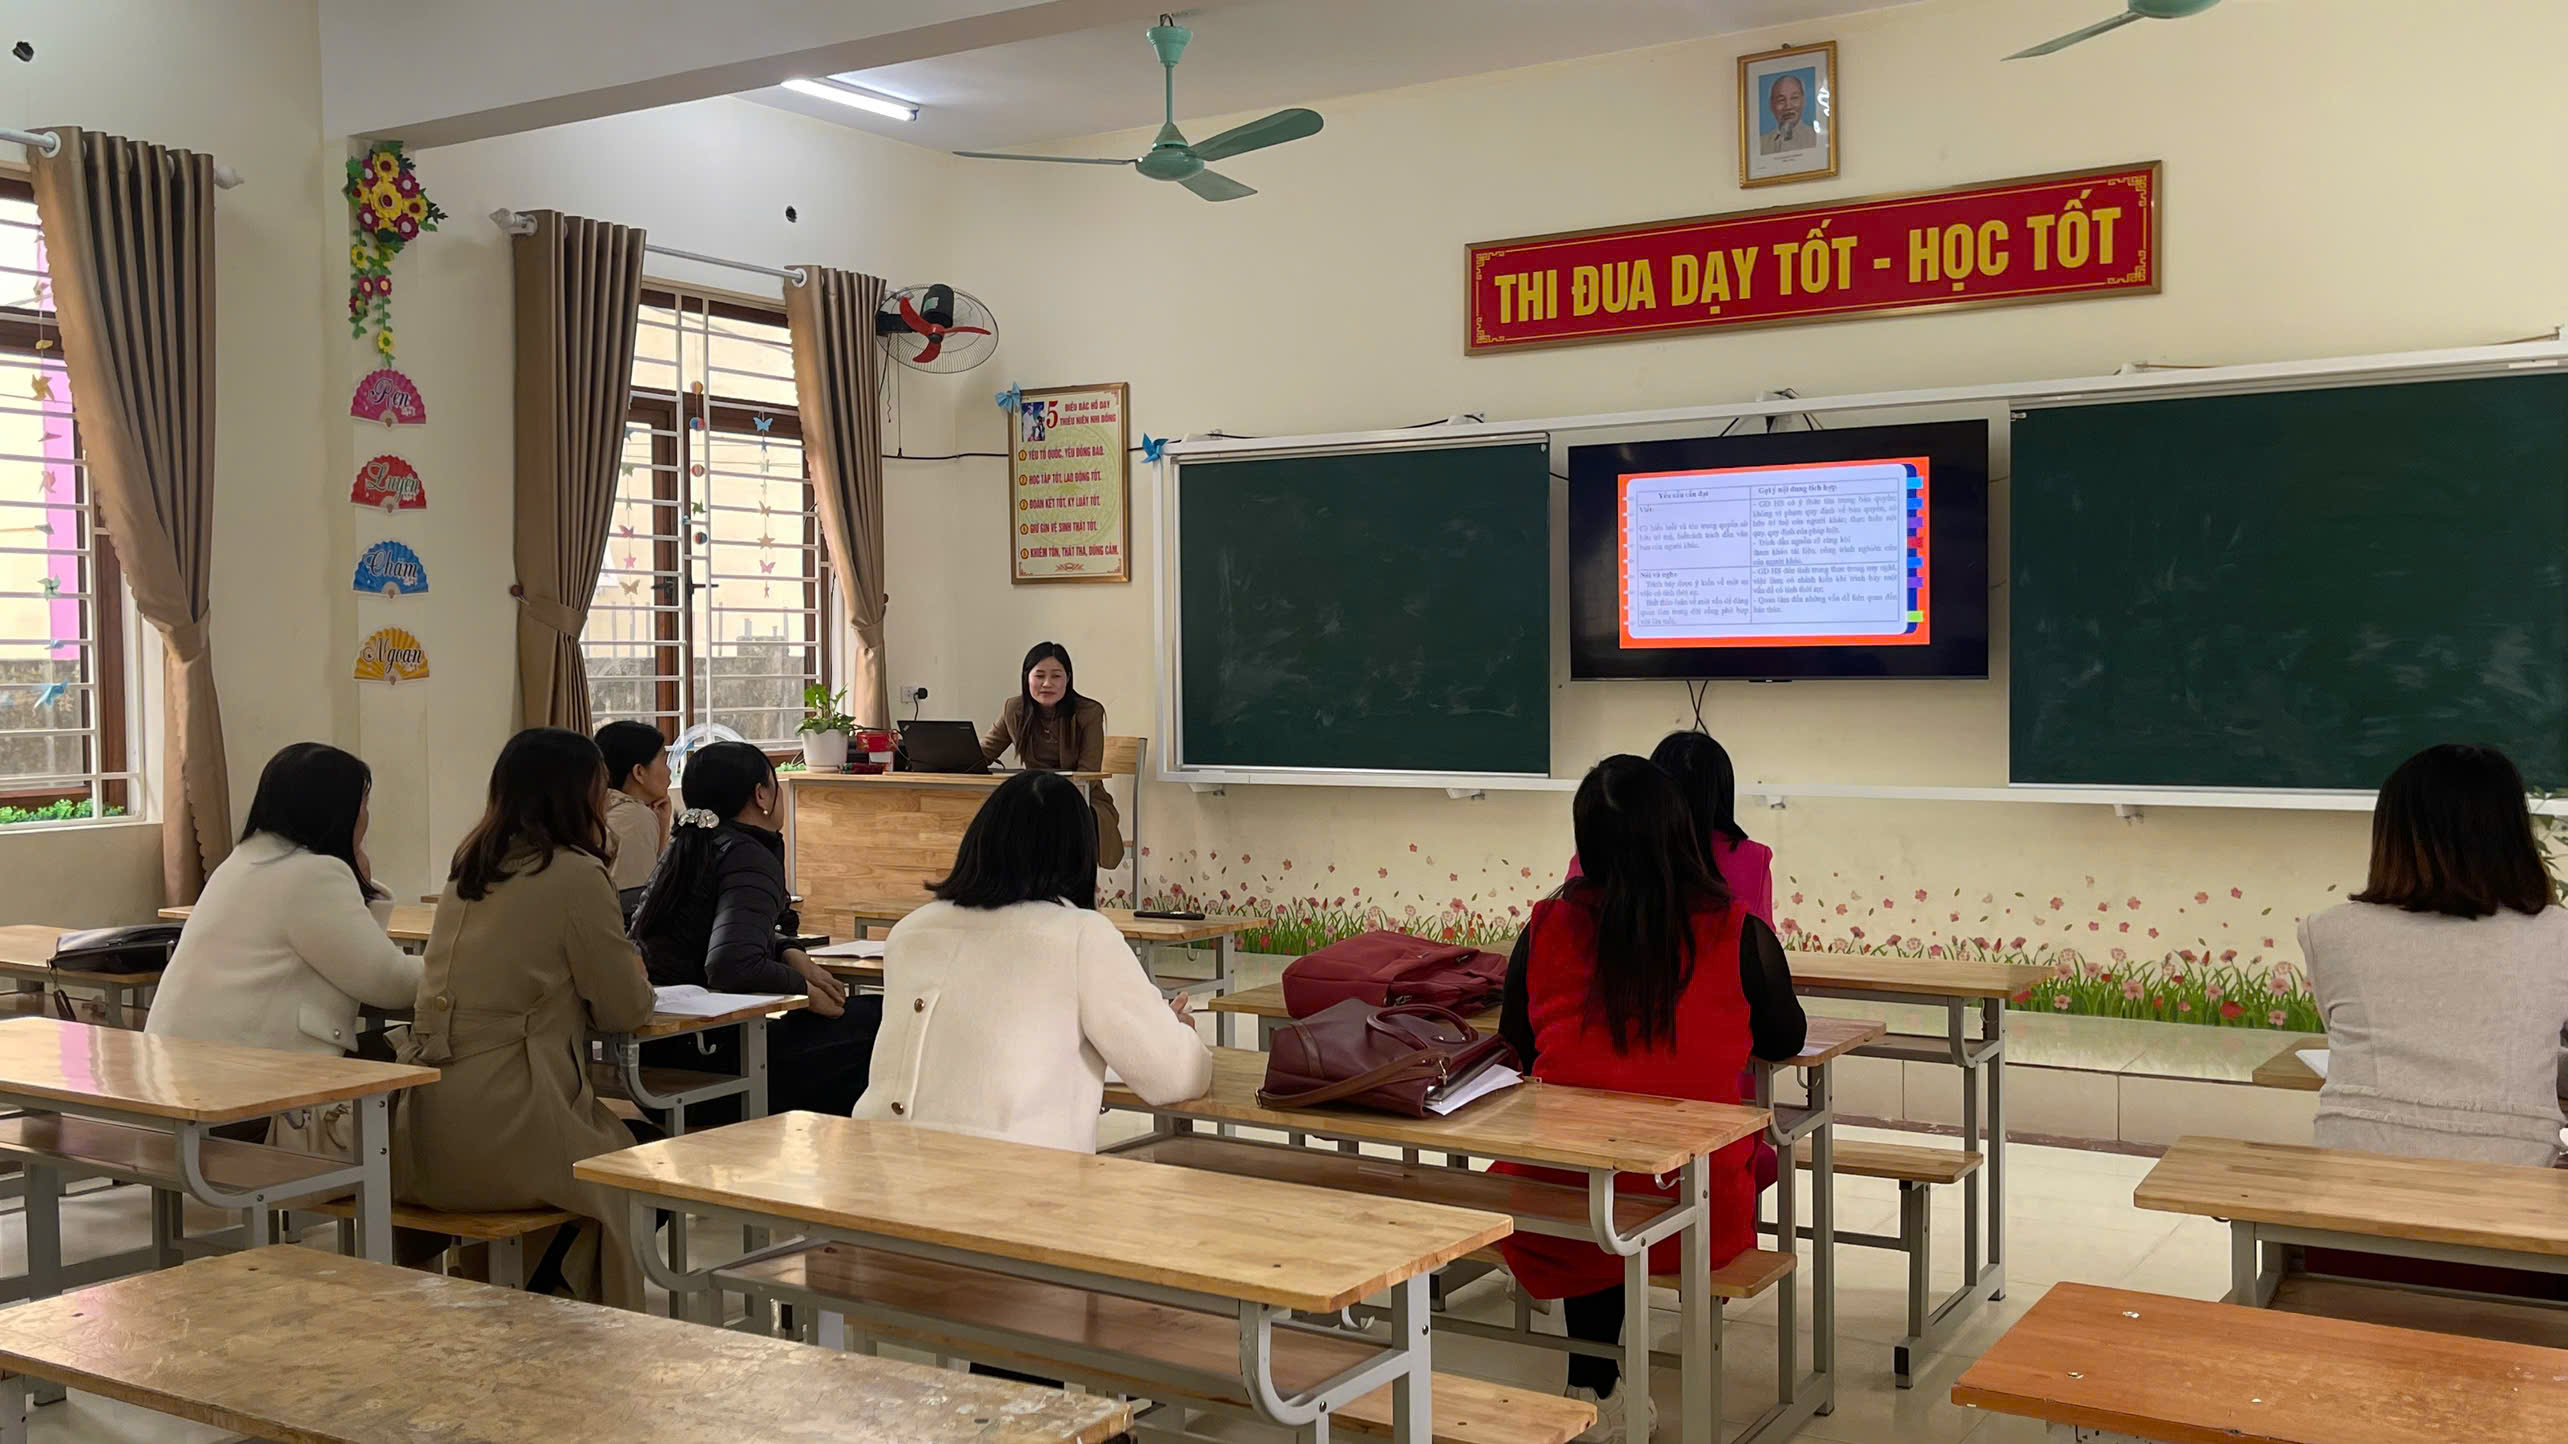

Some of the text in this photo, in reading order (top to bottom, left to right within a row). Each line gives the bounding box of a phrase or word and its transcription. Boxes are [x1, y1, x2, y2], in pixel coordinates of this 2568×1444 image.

[1494, 270, 1558, 324] THI
[1571, 258, 1657, 318] ĐUA
[1671, 246, 1759, 315] DẠY
[1773, 218, 1858, 296] TỐT
[1908, 219, 2009, 292] HỌC
[2026, 189, 2121, 272] TỐT
[1078, 401, 1089, 411] BÁC
[1091, 399, 1098, 410] HỒ
[1046, 400, 1058, 429] 5
[1064, 472, 1074, 483] LAO
[1059, 522, 1072, 532] SINH
